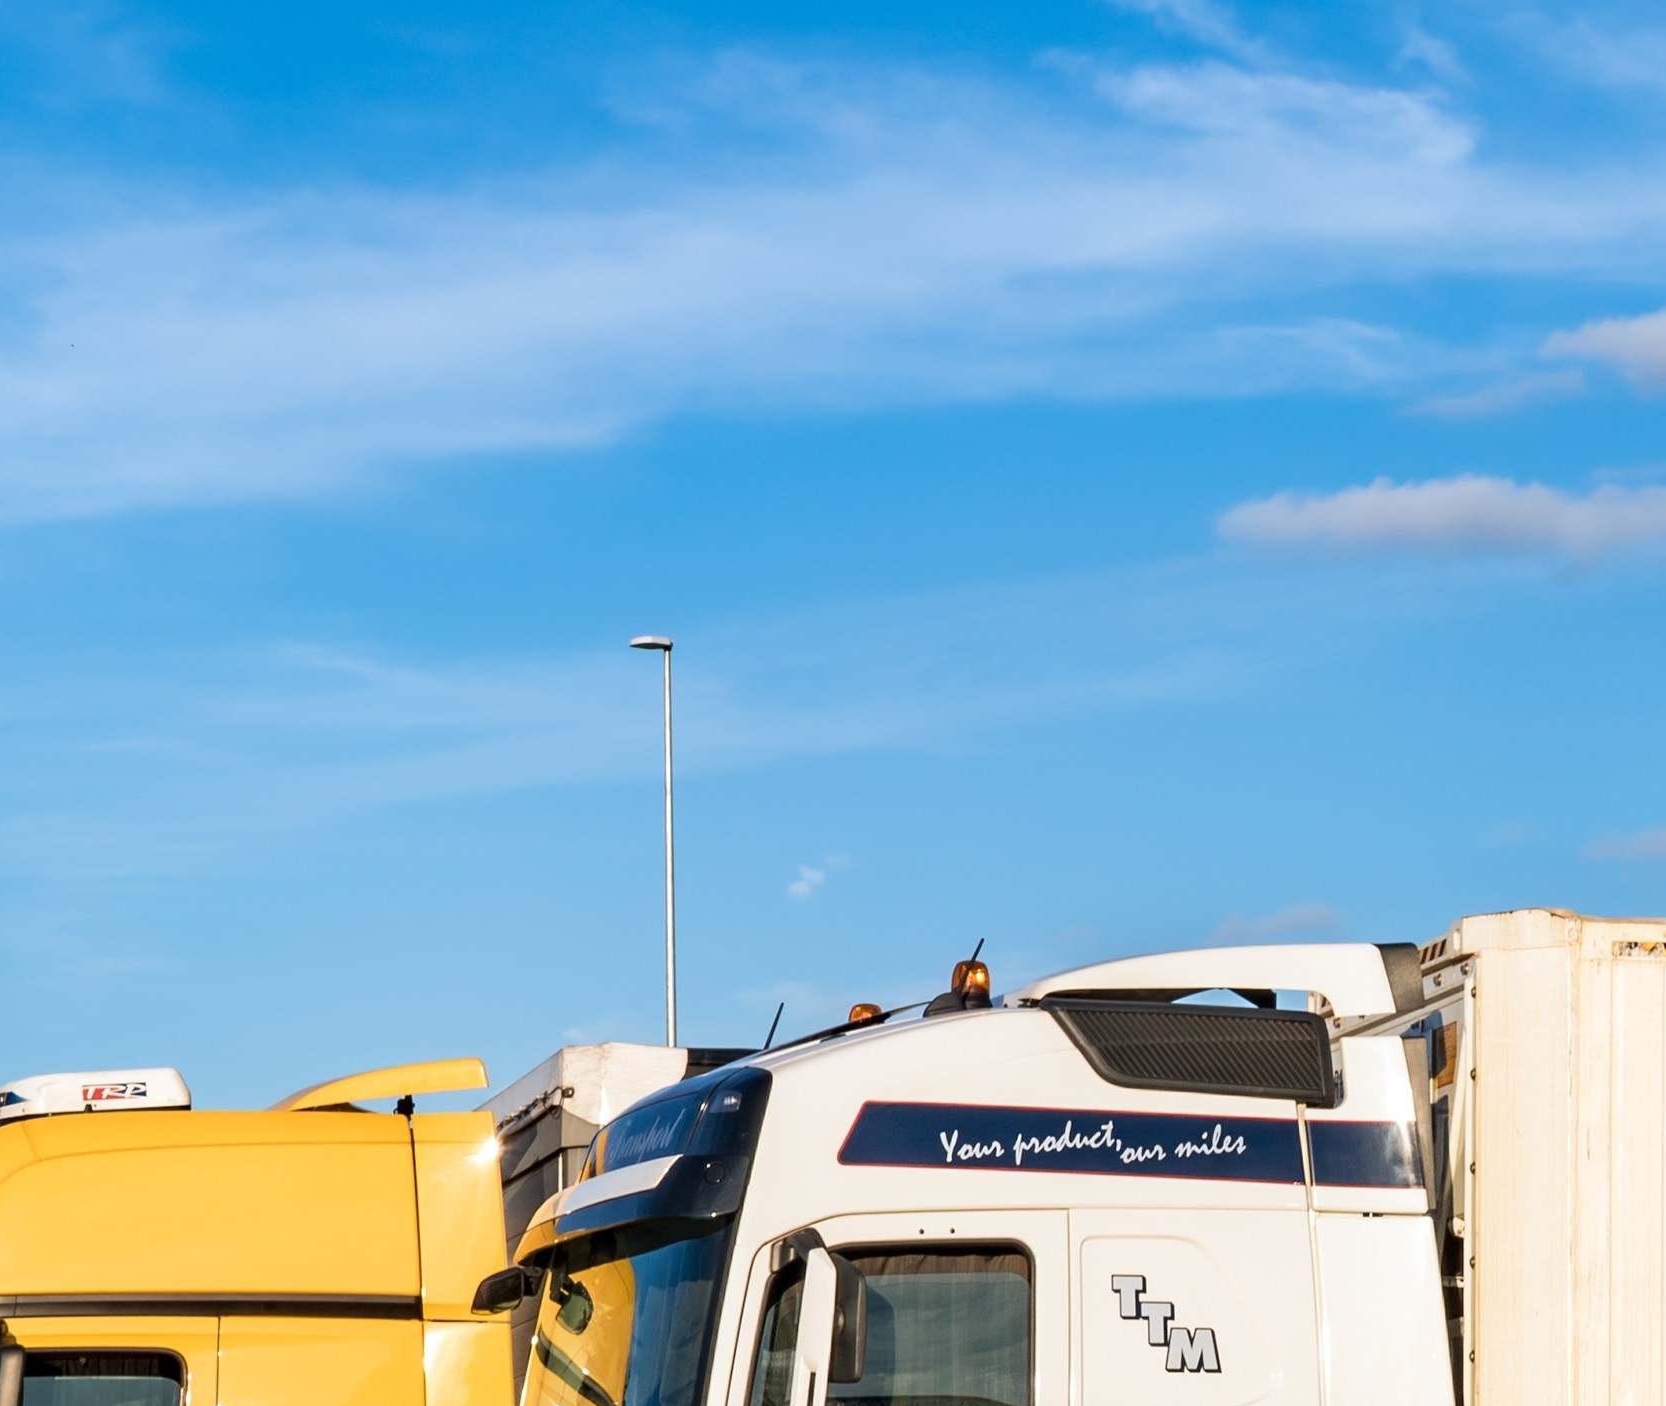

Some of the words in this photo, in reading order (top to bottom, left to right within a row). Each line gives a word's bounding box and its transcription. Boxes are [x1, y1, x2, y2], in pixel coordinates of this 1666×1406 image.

[83, 1084, 147, 1101] TRP
[939, 1129, 1004, 1163] Your
[1012, 1119, 1122, 1166] product,
[1120, 1143, 1167, 1164] our
[1174, 1123, 1247, 1159] miles
[1111, 1274, 1222, 1373] TTM
